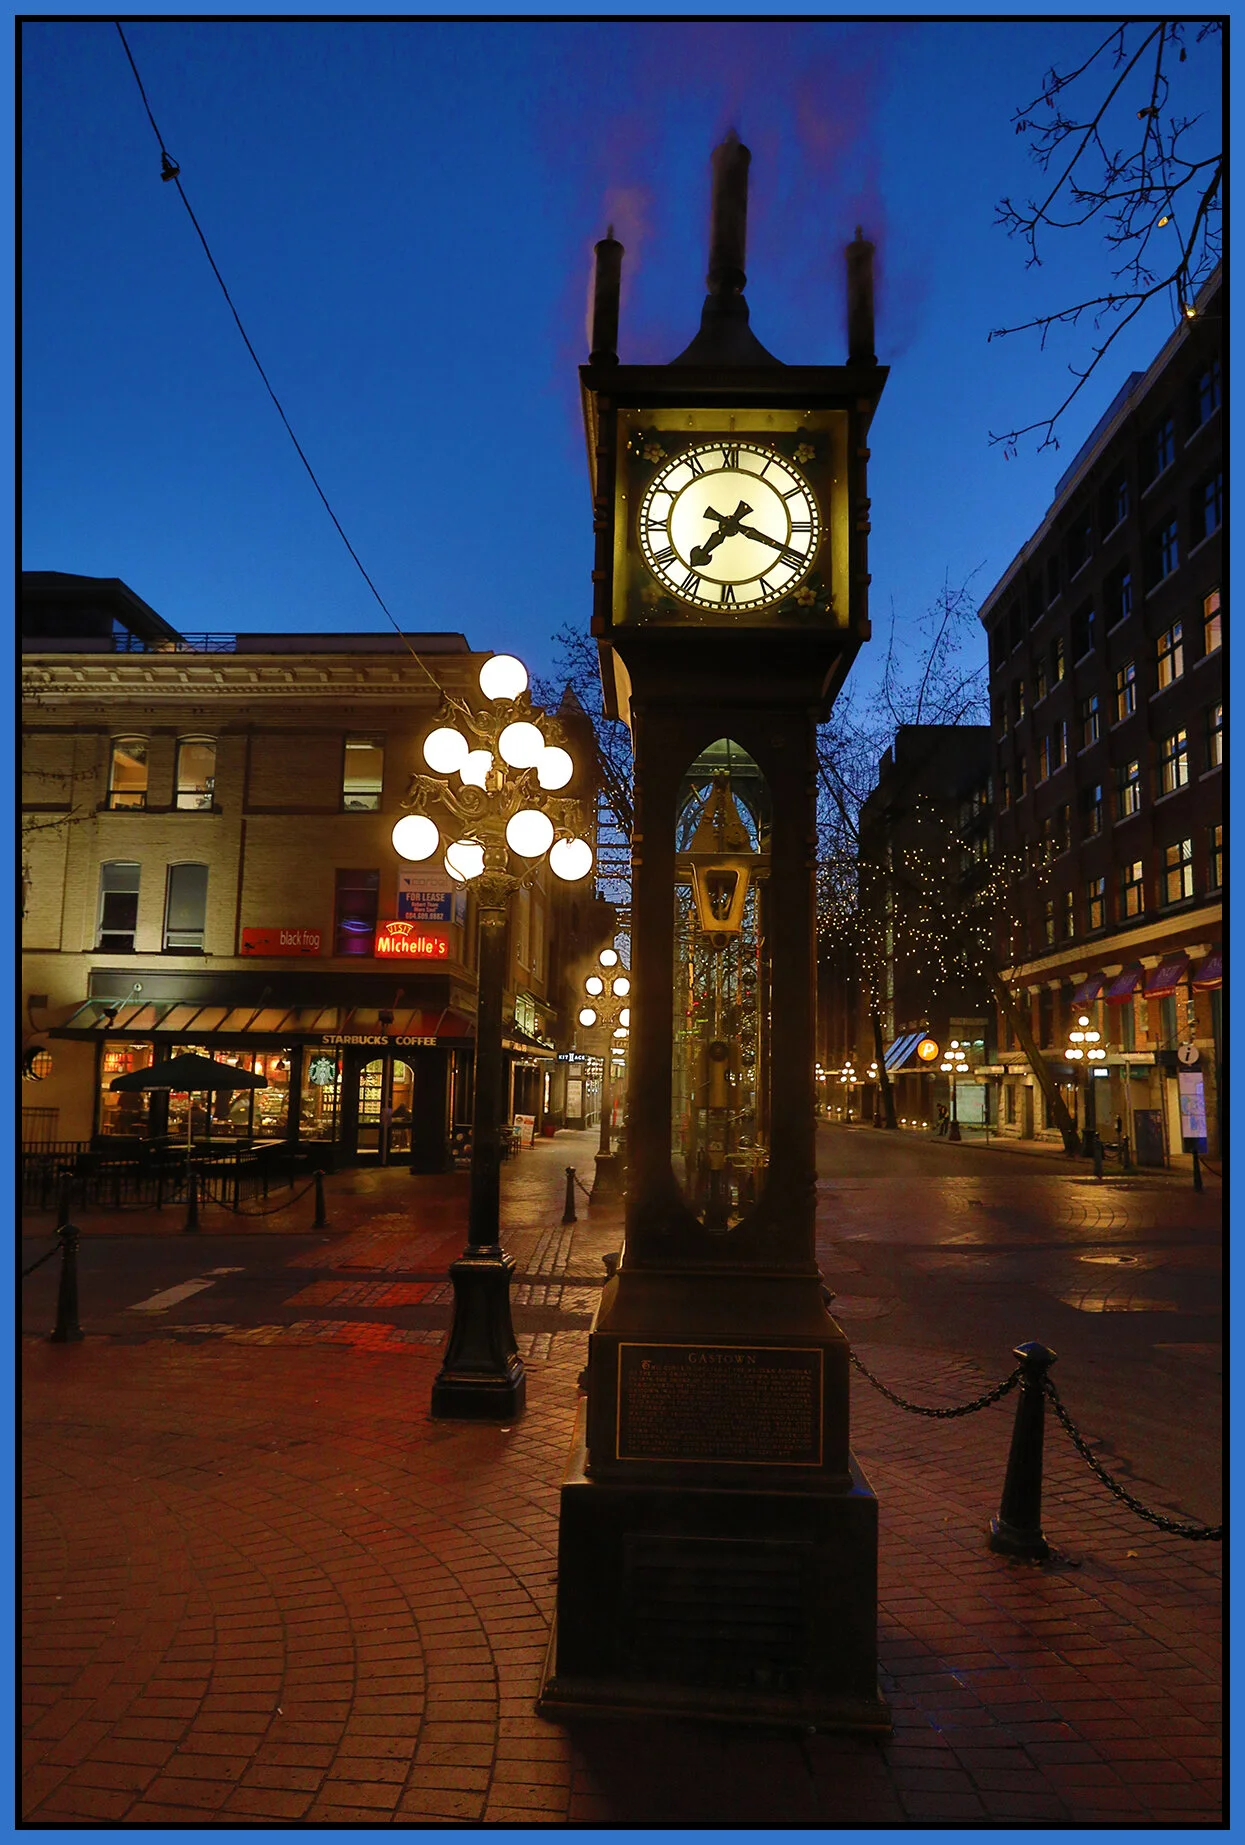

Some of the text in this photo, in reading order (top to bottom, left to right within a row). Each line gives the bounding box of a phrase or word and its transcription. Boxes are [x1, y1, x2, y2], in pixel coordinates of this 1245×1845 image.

[406, 893, 445, 902] FOR LEASE
[388, 924, 412, 934] VISIT
[280, 931, 320, 949] black frog
[322, 1035, 437, 1046] STARBUCKS COFFEE
[922, 1043, 934, 1057] P
[687, 1352, 756, 1365] GASTOWN
